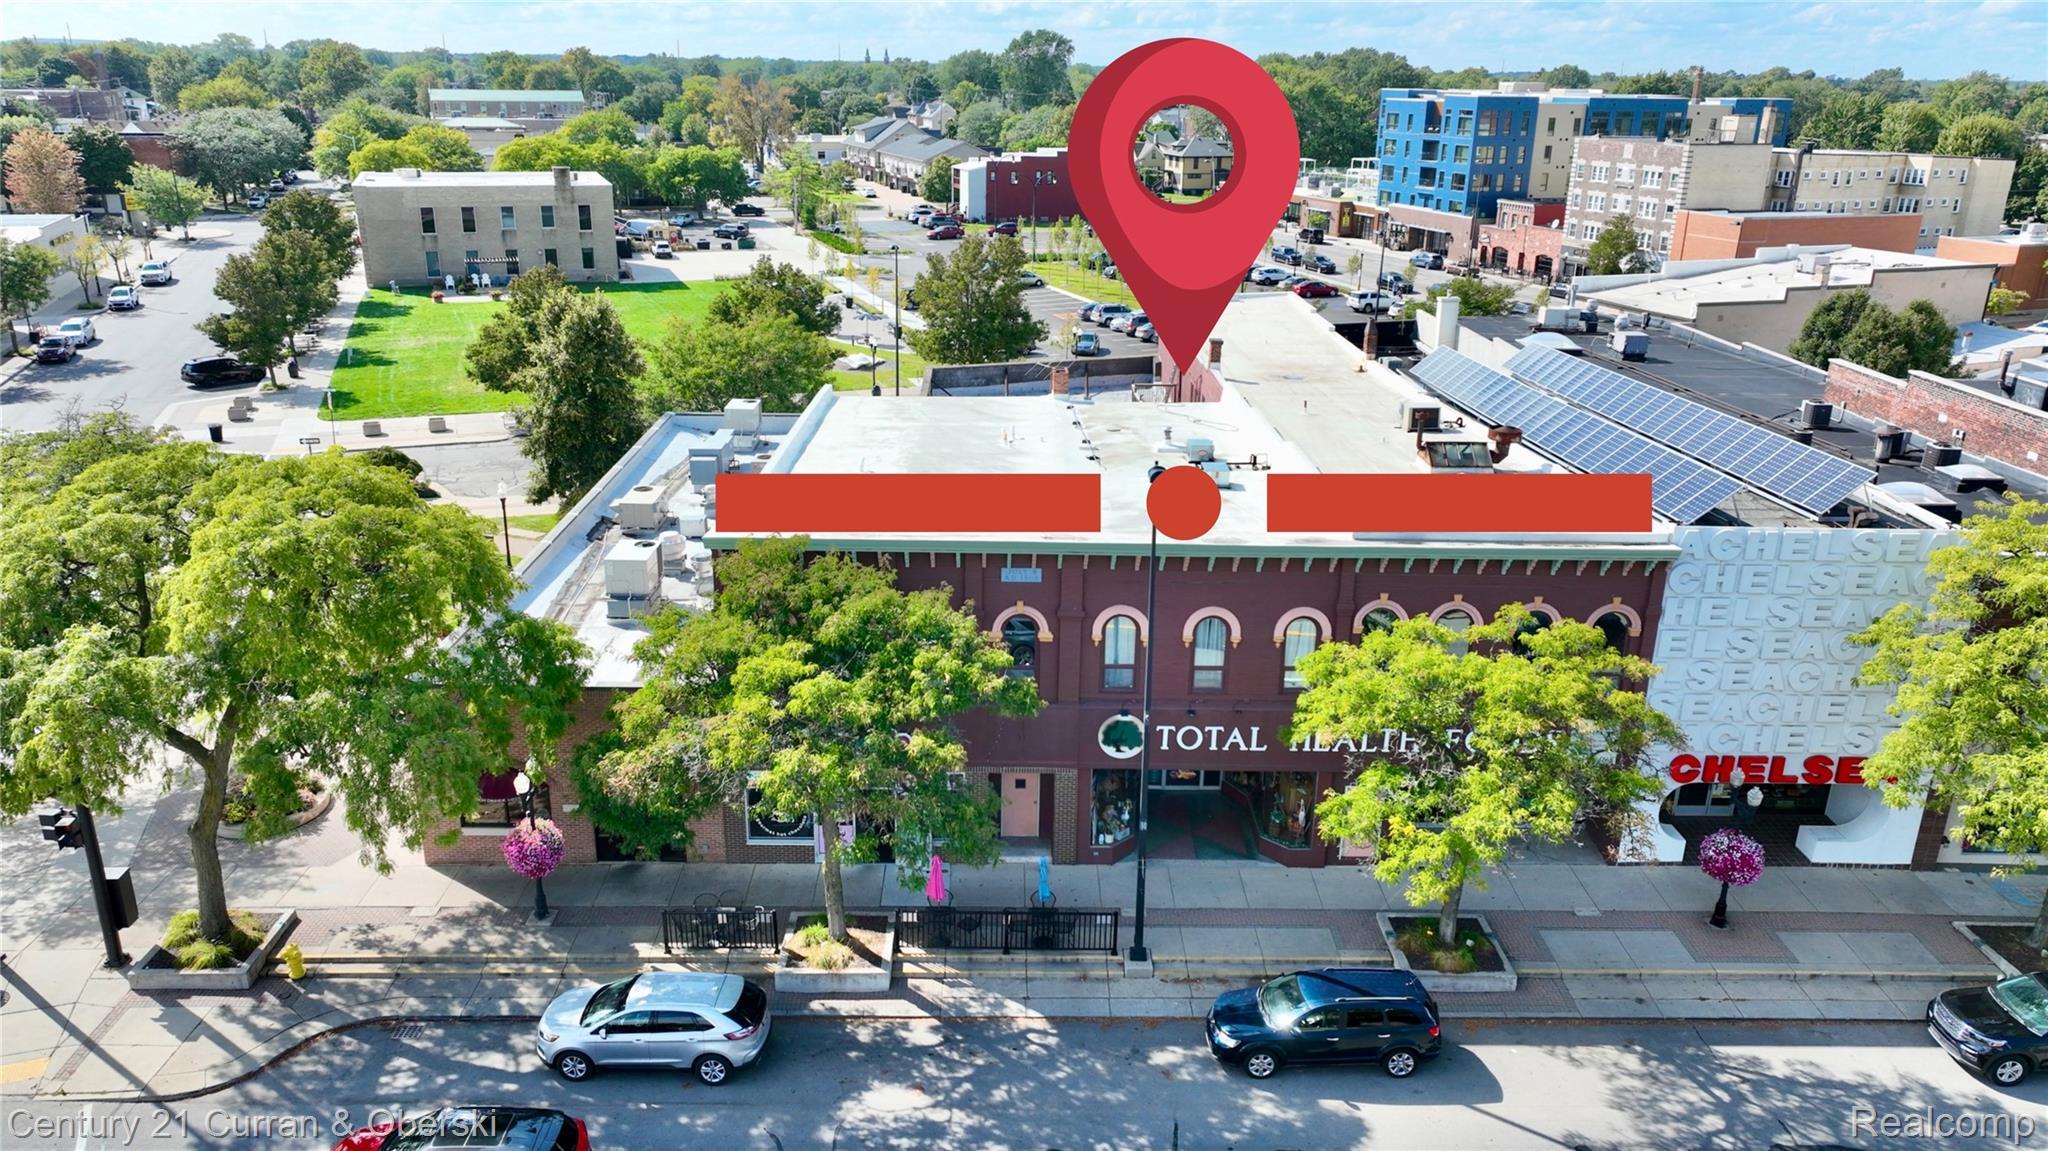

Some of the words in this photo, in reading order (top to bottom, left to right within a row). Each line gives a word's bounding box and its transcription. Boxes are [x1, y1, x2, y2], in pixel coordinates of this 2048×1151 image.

[1652, 660, 1889, 693] LSEACH
[1156, 725, 1268, 752] TOTAL
[1669, 754, 1899, 785] CHELSE
